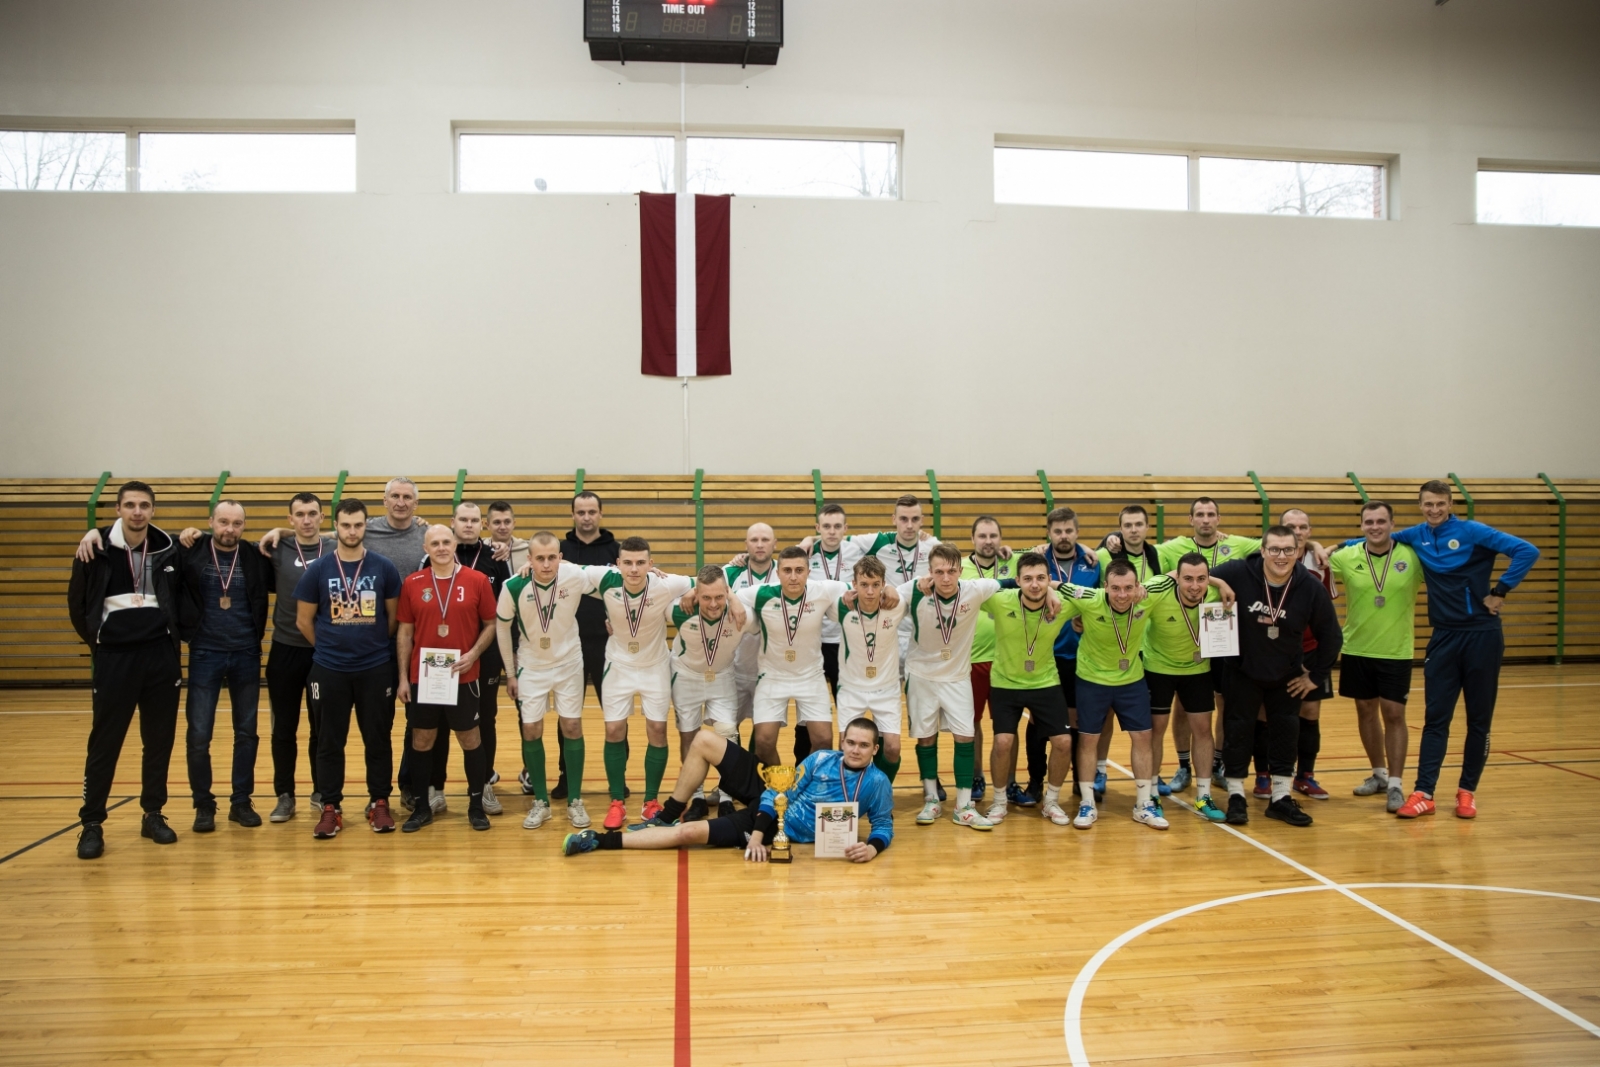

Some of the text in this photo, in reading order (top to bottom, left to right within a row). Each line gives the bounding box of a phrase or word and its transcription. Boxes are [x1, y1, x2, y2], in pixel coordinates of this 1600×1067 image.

[612, 5, 620, 14] 13
[661, 4, 706, 14] TIME OUT
[748, 2, 756, 10] 12
[612, 14, 620, 23] 14
[748, 10, 756, 19] 13
[612, 23, 620, 33] 15
[748, 19, 756, 28] 14
[748, 28, 756, 37] 15
[457, 586, 465, 602] 3
[788, 615, 799, 631] 3
[865, 632, 875, 647] 2
[311, 682, 320, 700] 18
